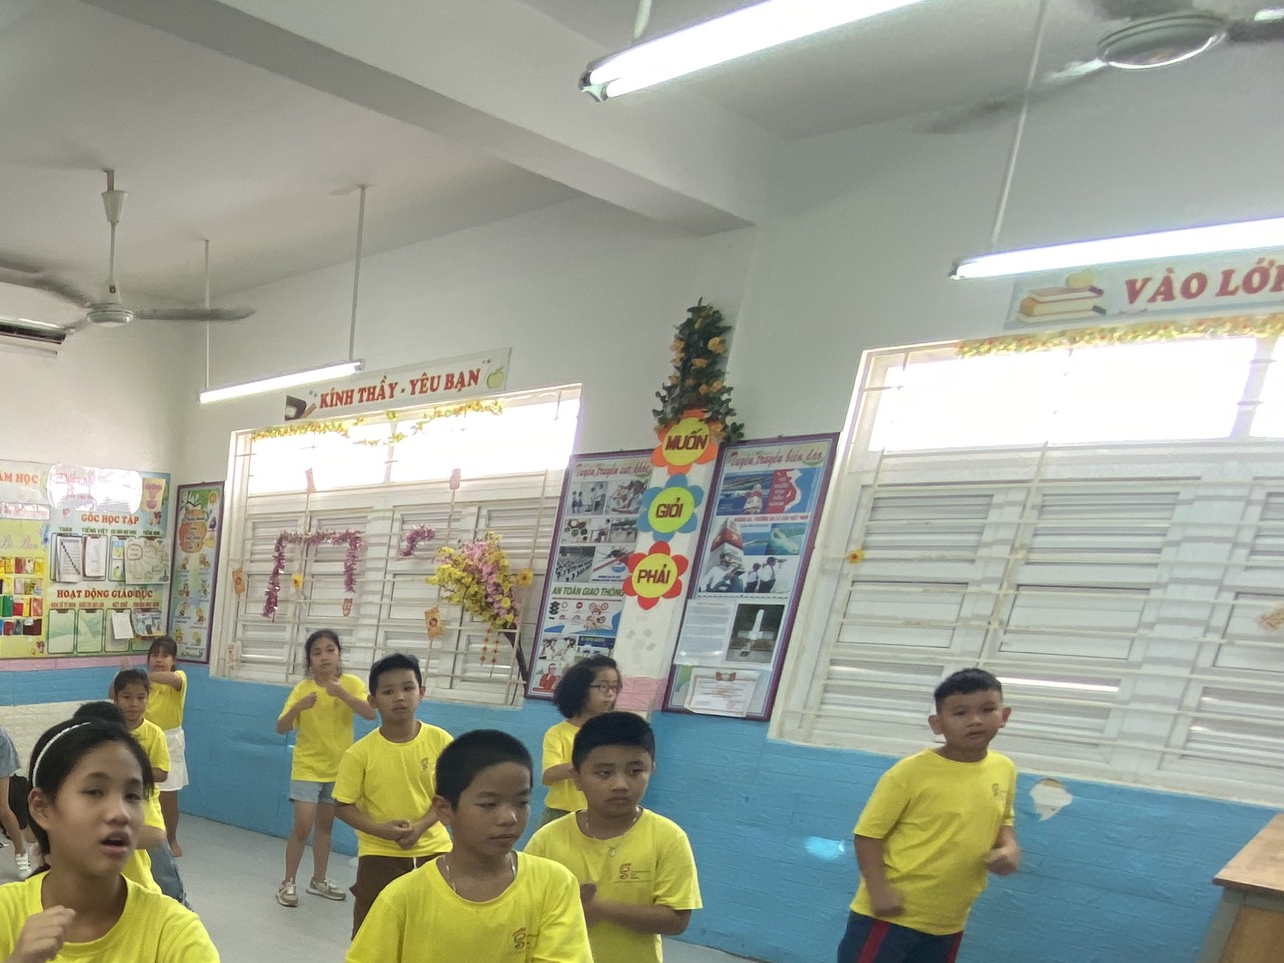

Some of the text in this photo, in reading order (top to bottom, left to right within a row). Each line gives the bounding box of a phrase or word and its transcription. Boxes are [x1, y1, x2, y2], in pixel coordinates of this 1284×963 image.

[319, 387, 355, 409] KÍNH
[357, 374, 398, 404] THẦY
[409, 372, 442, 396] YÊU
[444, 368, 481, 393] BẠN
[665, 428, 709, 451] MUỐN
[15, 473, 39, 485] HỌC
[655, 497, 683, 519] GIỎI
[81, 511, 140, 525] GÓC HỌC TẬP
[637, 563, 671, 584] PHẢI
[57, 588, 153, 600] HOẠT ĐỘNG GIÁO DỤC
[552, 587, 563, 595] AN
[564, 586, 582, 595] TOÀN
[582, 587, 600, 596] GIAO
